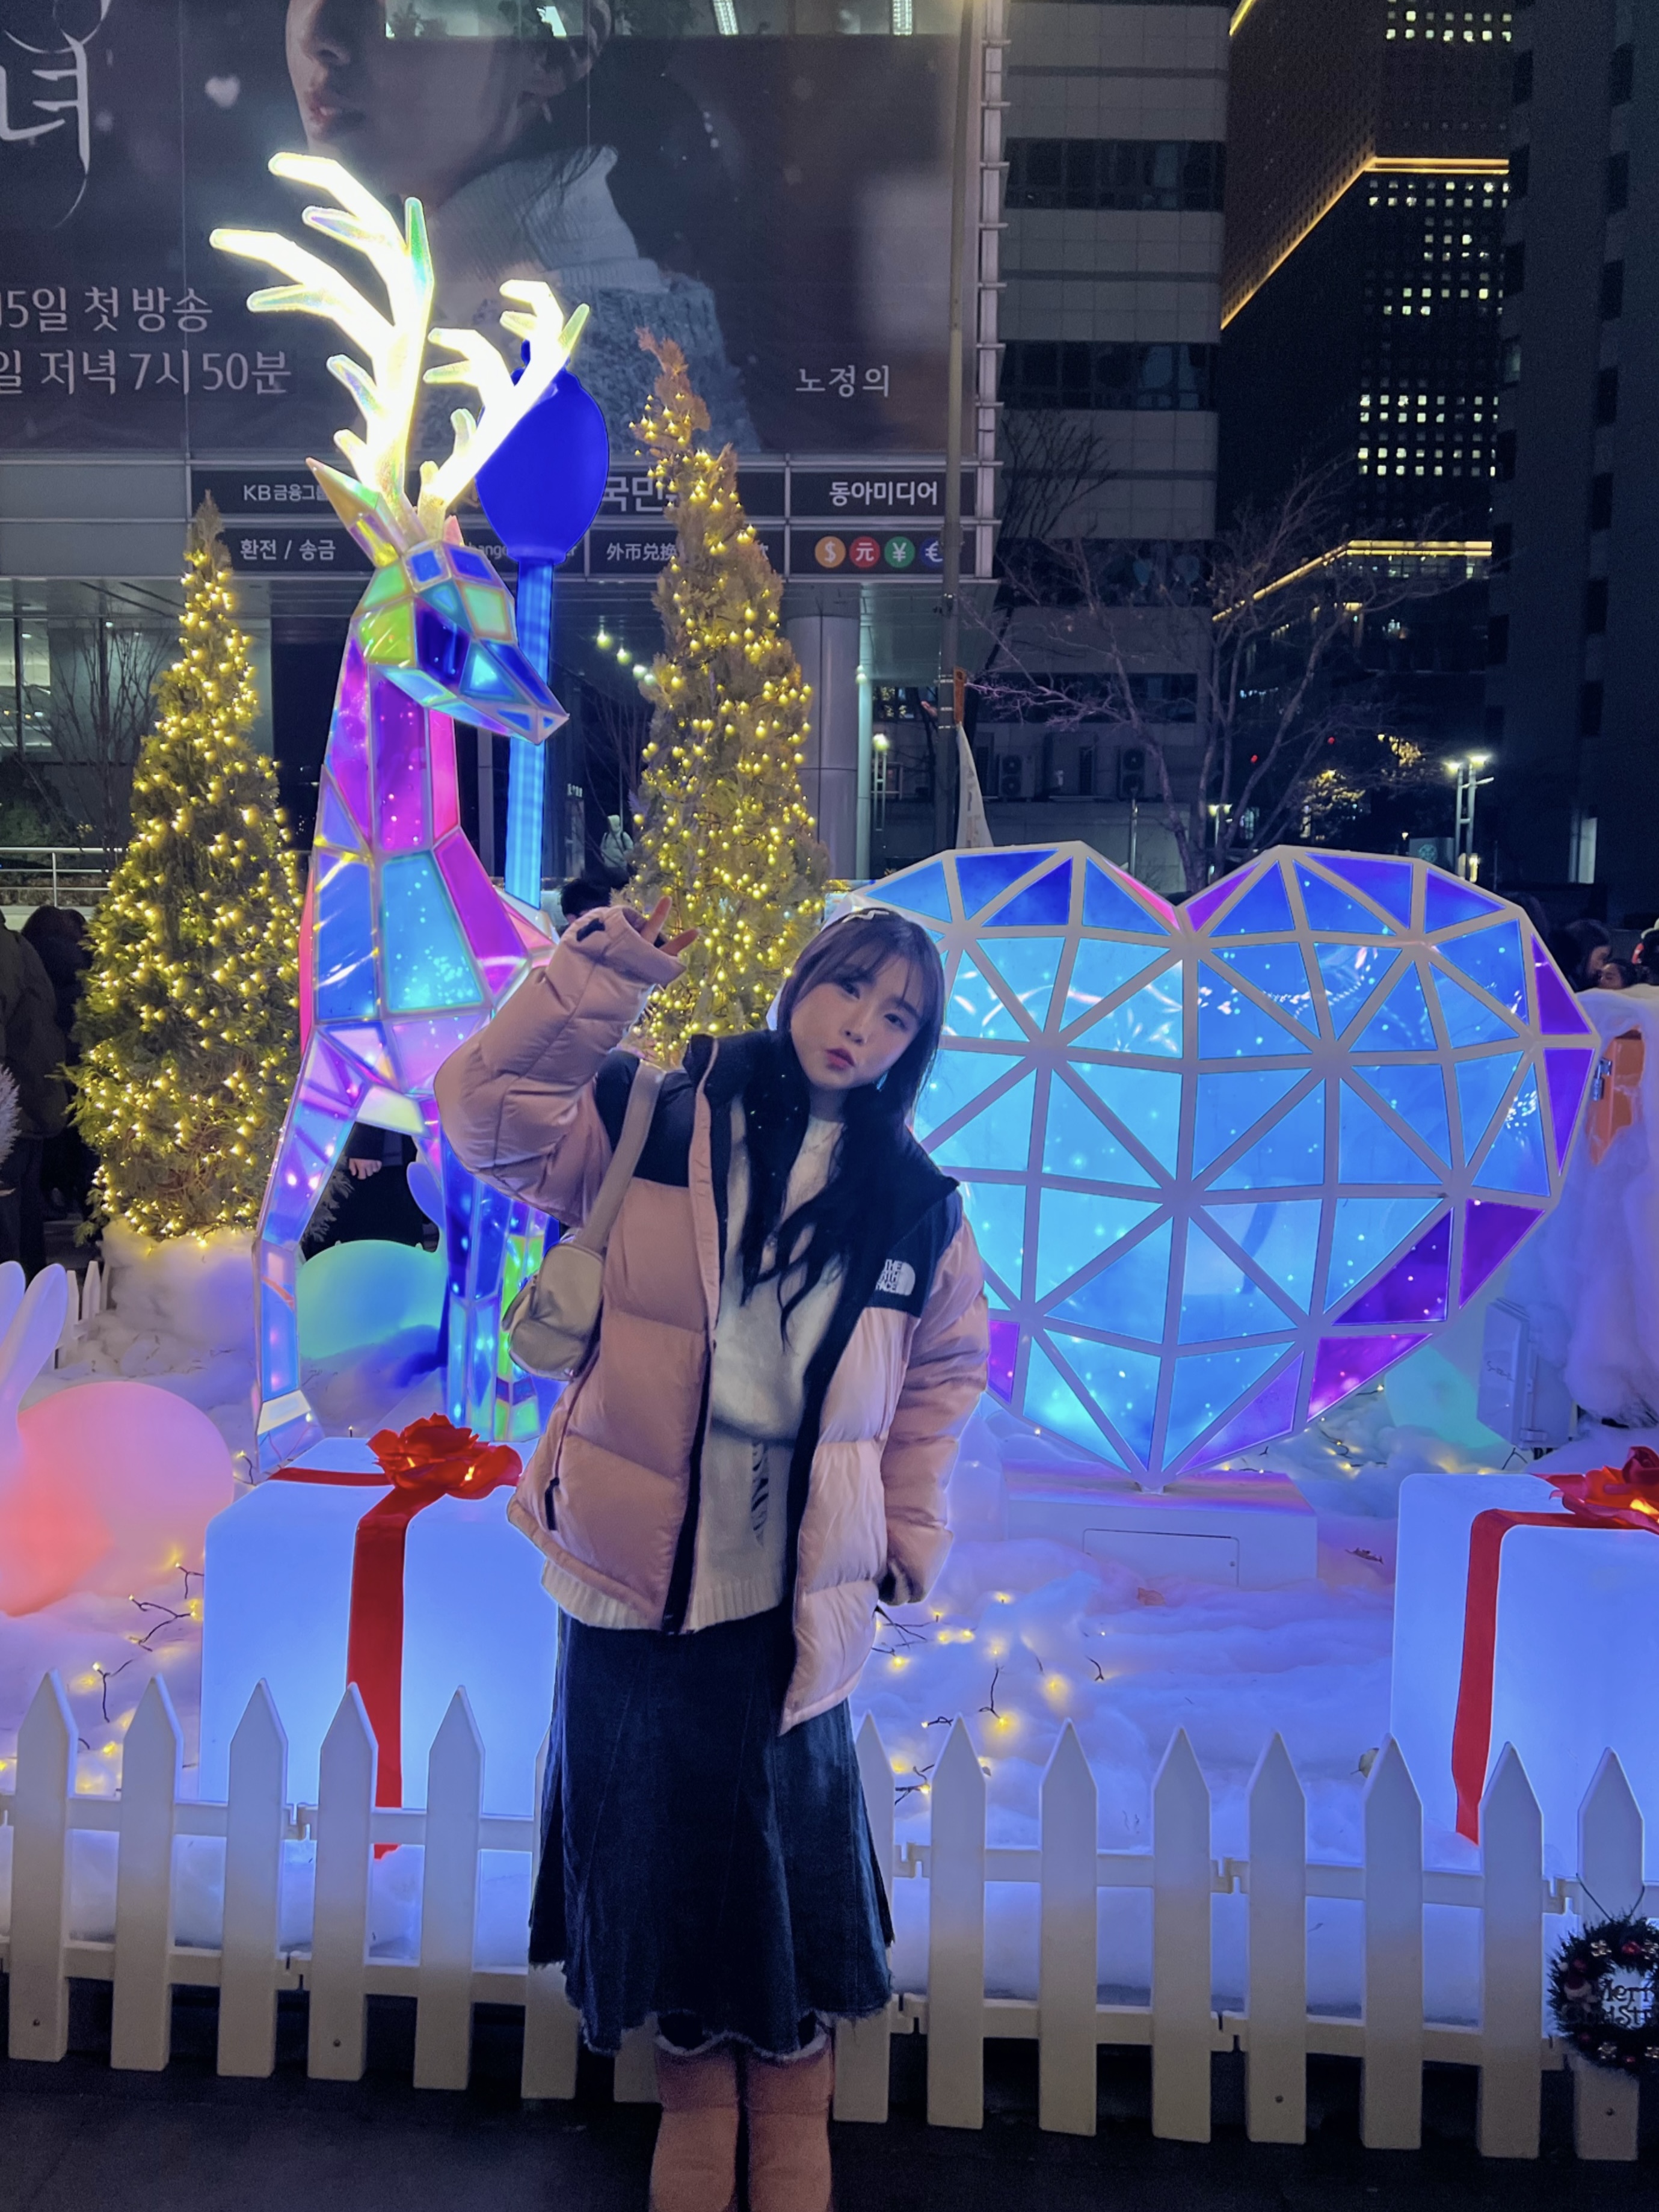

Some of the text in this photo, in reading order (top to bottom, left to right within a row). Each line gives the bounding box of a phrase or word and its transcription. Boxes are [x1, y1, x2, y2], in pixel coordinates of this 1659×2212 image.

[84, 286, 118, 331] 첫
[132, 286, 212, 332] 방송
[40, 349, 116, 395] 저녁
[129, 349, 189, 395] 7시
[202, 350, 291, 395] 50분
[795, 364, 889, 398] 노정의
[602, 476, 678, 512] 국민
[829, 481, 937, 506] 동아미디어
[241, 538, 277, 561] 환전
[299, 539, 336, 561] 송금
